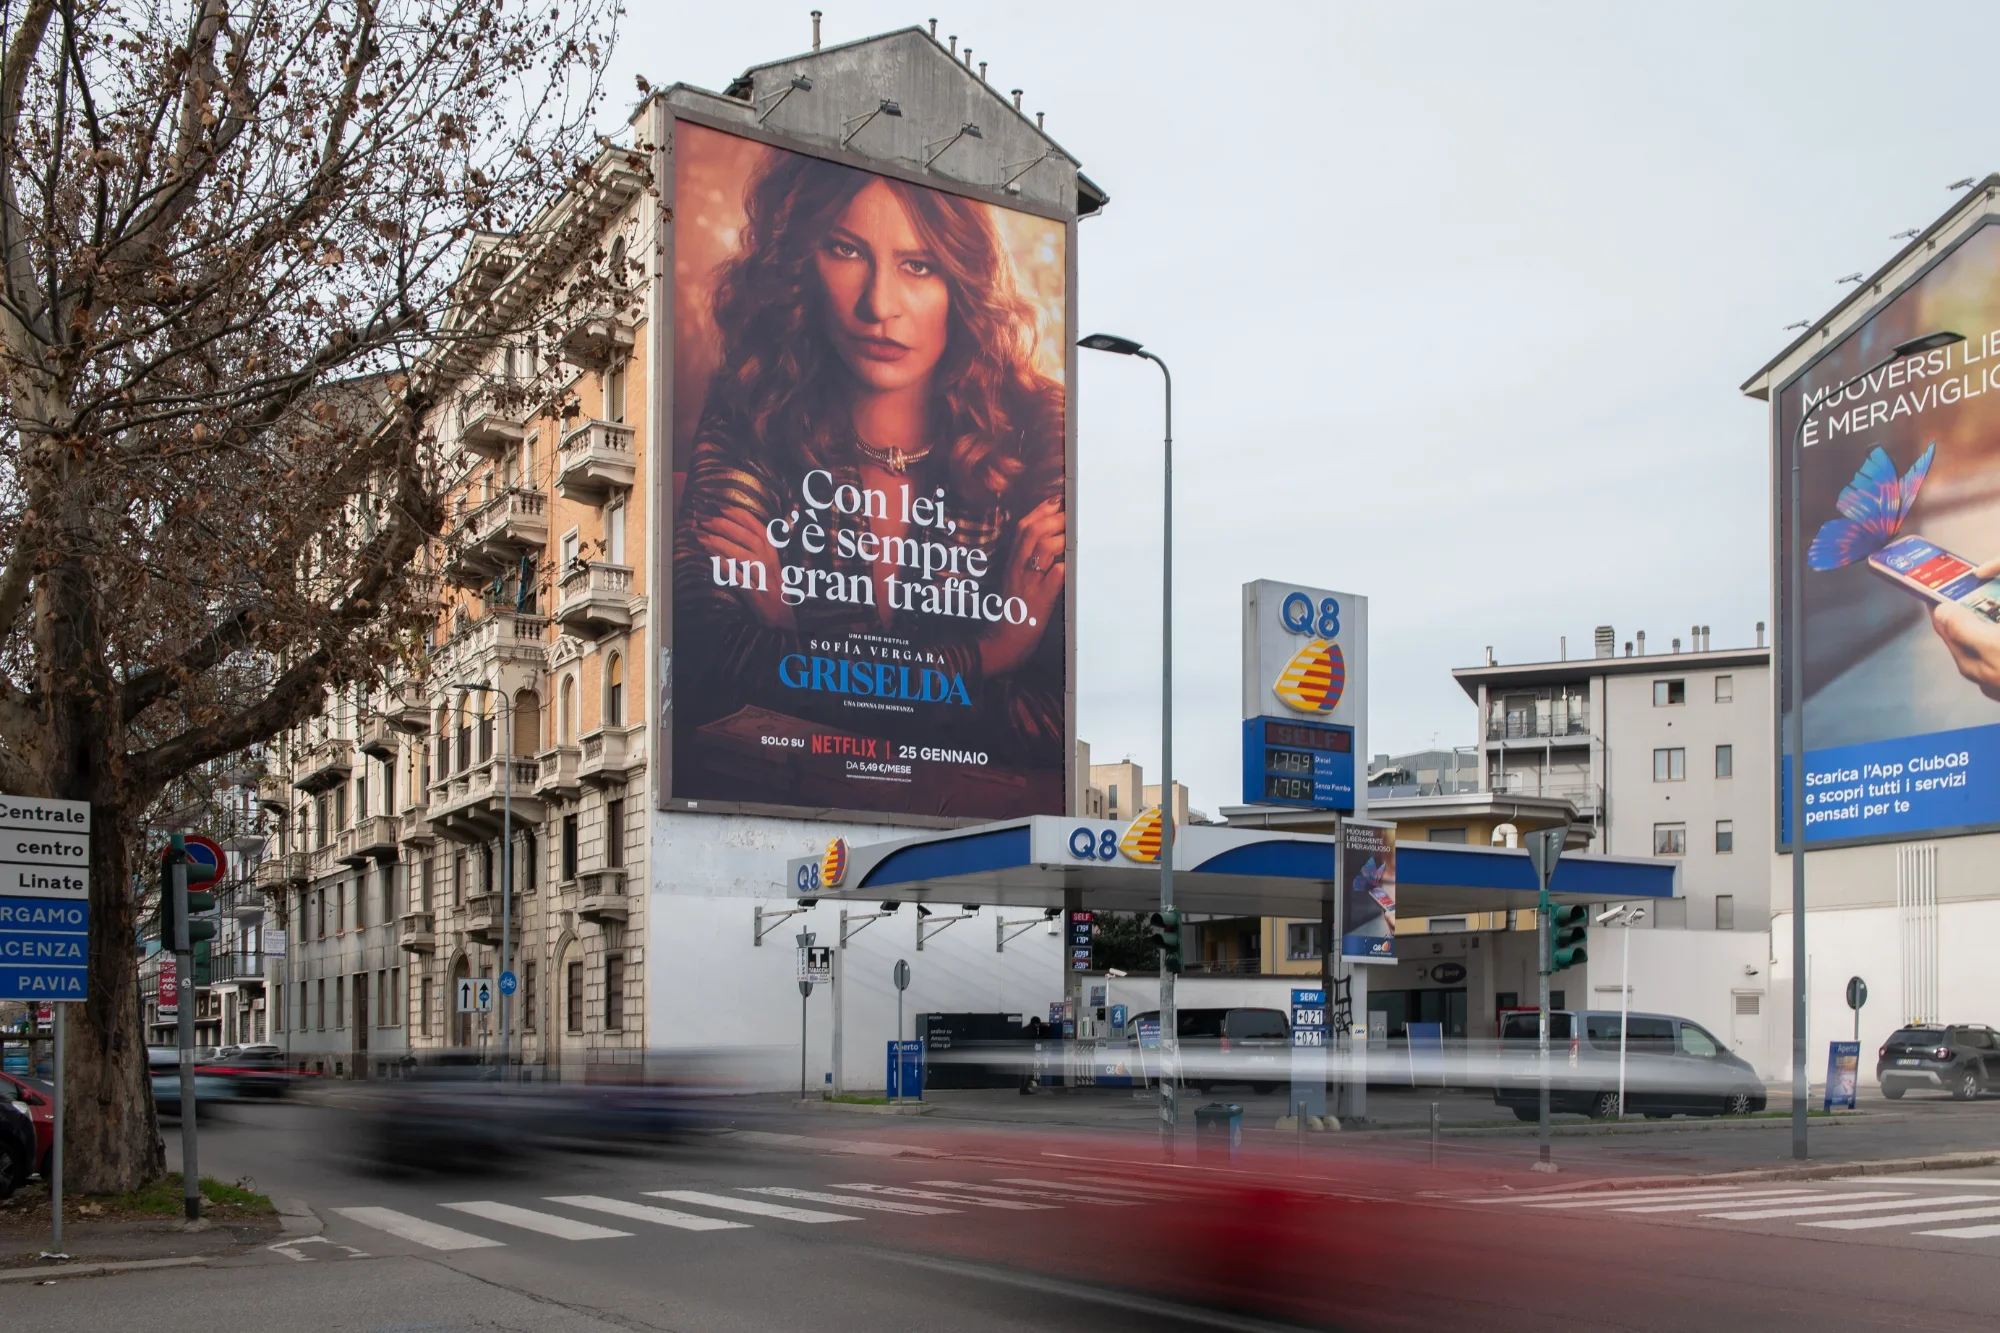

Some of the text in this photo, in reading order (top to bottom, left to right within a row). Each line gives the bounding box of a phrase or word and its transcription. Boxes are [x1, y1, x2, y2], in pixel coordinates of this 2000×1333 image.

[1802, 346, 1951, 417] MUOVERSI
[802, 469, 957, 536] Con lei,
[837, 527, 988, 580] sempre
[710, 554, 1038, 626] un gran traffico.
[1280, 591, 1340, 639] Q8
[810, 639, 946, 665] SOFÍA VERGARA
[884, 637, 910, 645] NETFLIX
[779, 653, 973, 706] GRISELDA
[856, 701, 877, 710] DONNA
[885, 704, 914, 713] SOSTANZA
[761, 734, 988, 765] SOLO SU NETFLIX 25 GENNAIO
[1278, 726, 1338, 749] SELF
[846, 760, 912, 774] DA 5,49 €/MESE
[1805, 768, 1859, 787] Scarica
[1908, 751, 1969, 773] ClubQ8
[1805, 771, 1966, 805] e scopri tutti i servizi
[0, 803, 85, 824] Centrale
[1805, 799, 1910, 826] pensati per te
[16, 841, 84, 857] centro
[1068, 827, 1117, 861] Q8
[19, 873, 84, 890] Linate
[797, 862, 819, 891] Q8
[0, 906, 83, 925] RGAMO
[1073, 912, 1090, 921] SELF
[19, 975, 82, 991] PAVIA
[1300, 992, 1319, 1001] SERV
[1838, 1044, 1858, 1054] Aperto
